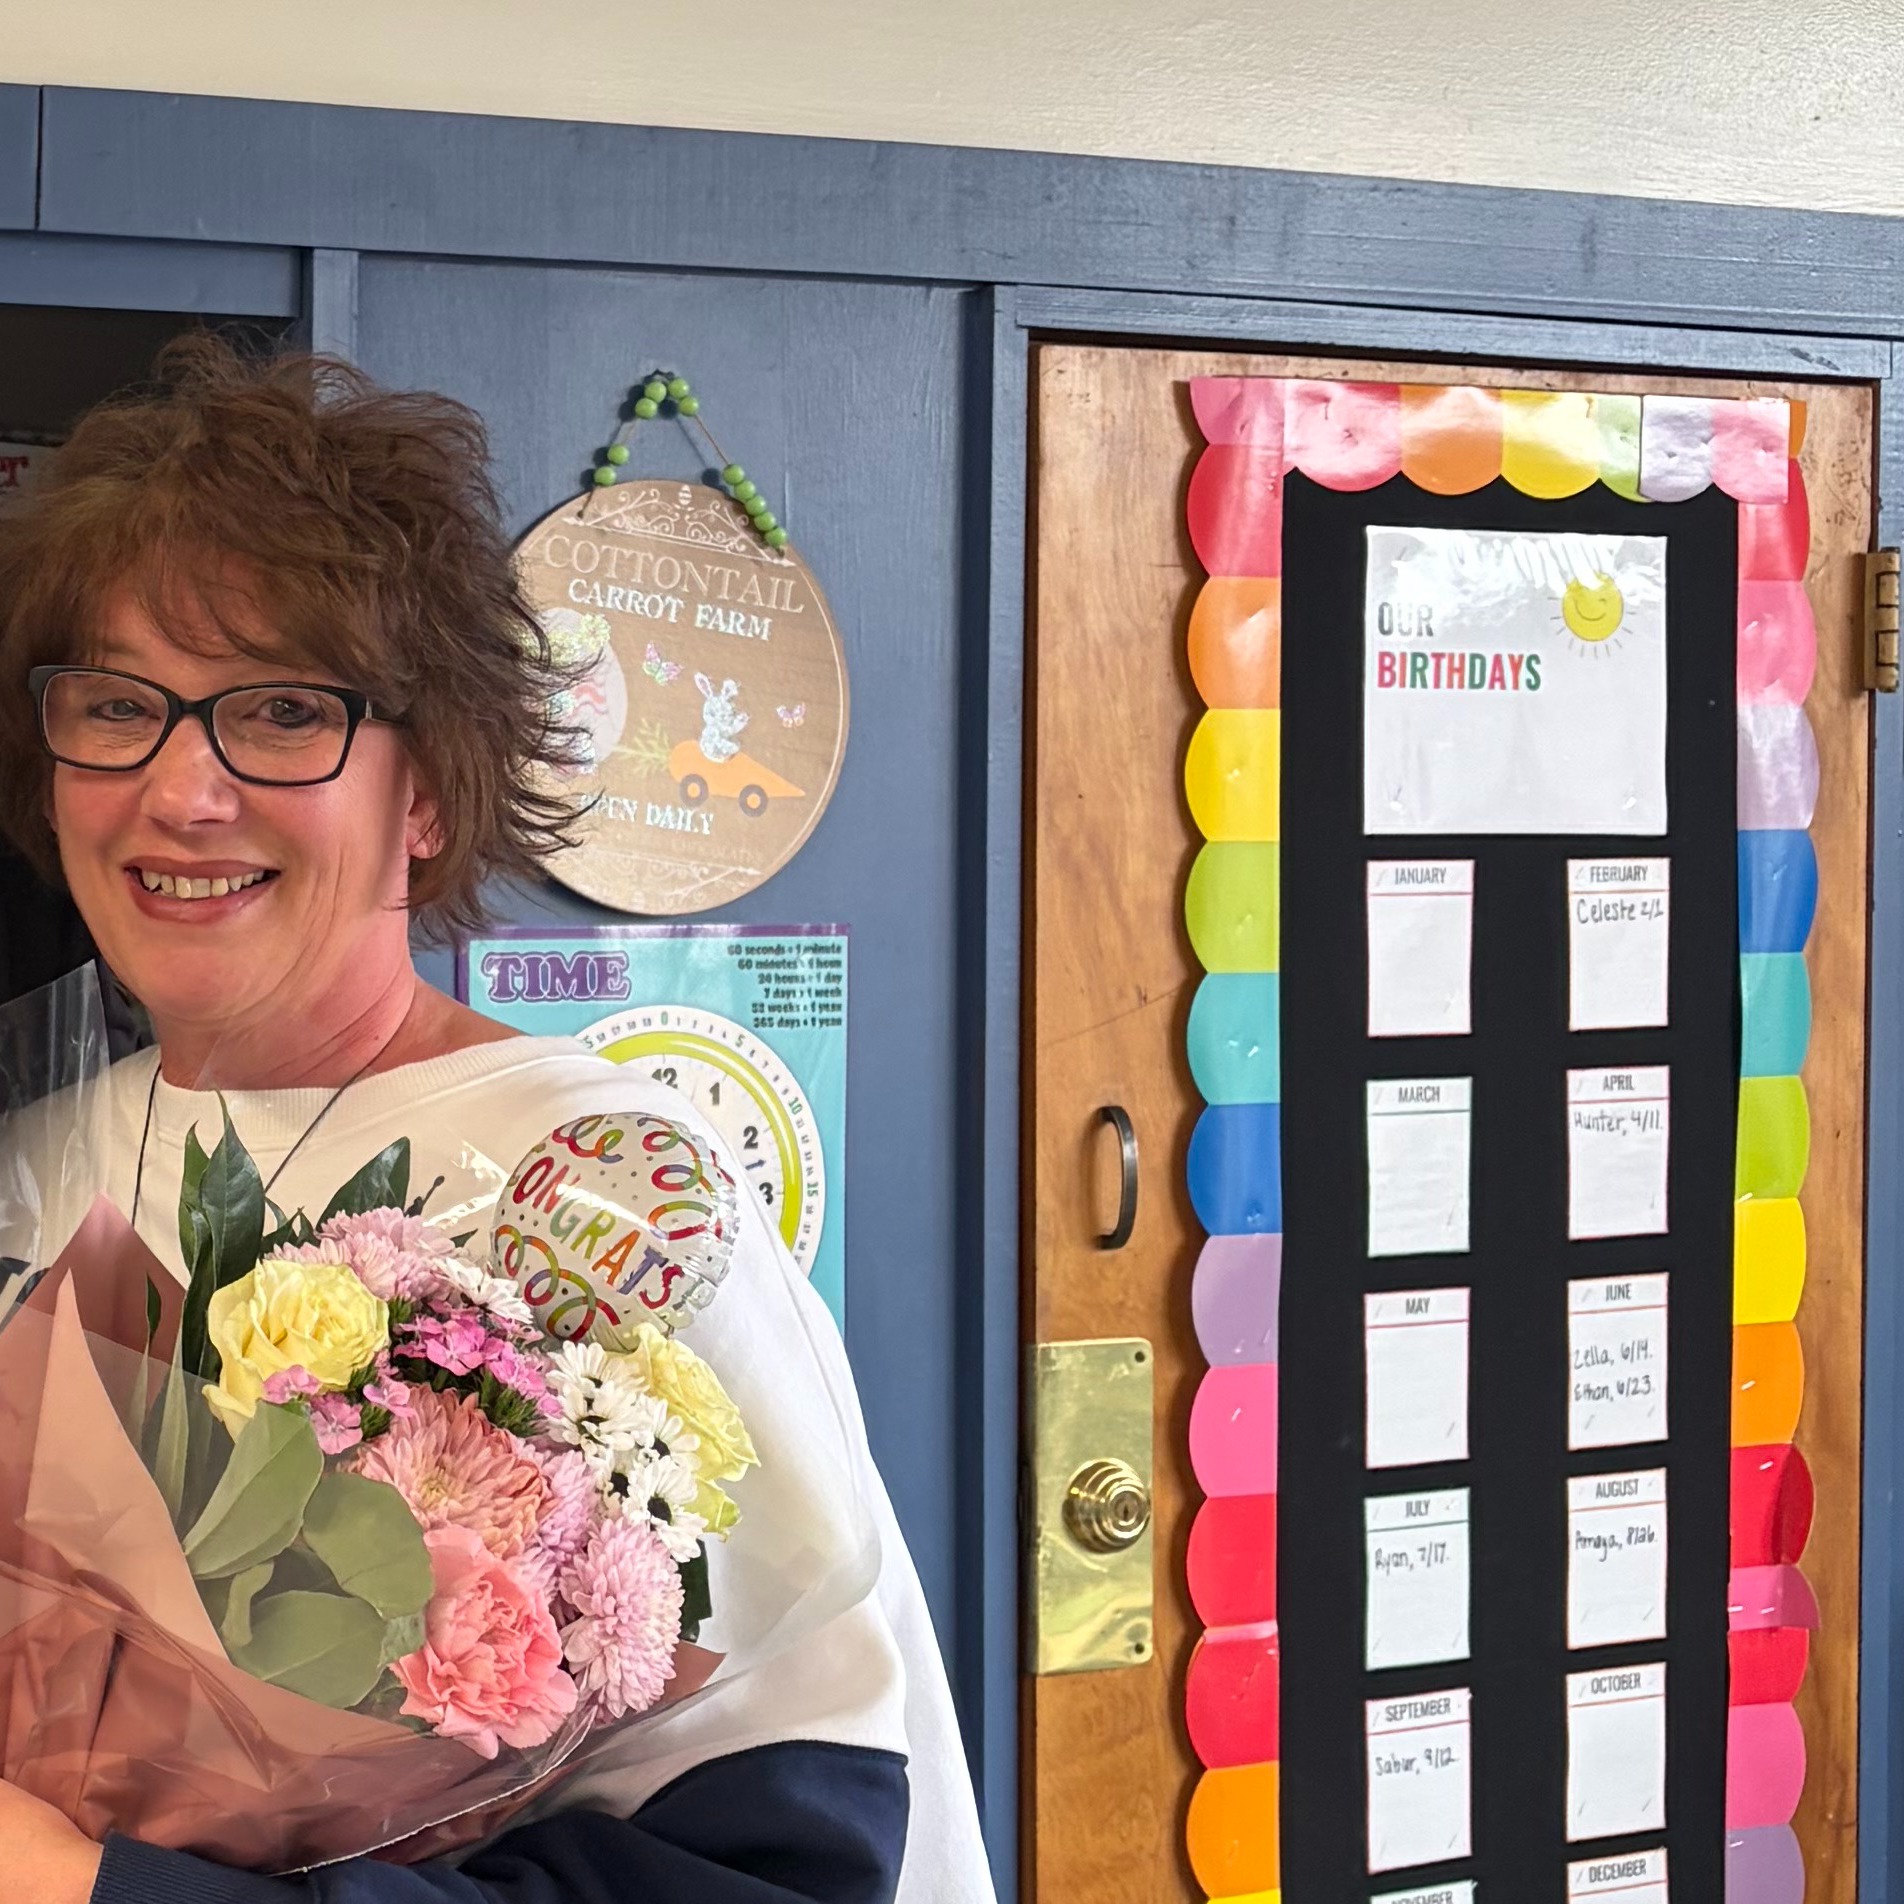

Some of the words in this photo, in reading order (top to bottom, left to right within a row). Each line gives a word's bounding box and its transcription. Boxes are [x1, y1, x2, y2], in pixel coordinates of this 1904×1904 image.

[543, 534, 806, 615] COTTONTAIL
[567, 579, 685, 625] CARROT
[694, 604, 773, 642] FARM
[1378, 601, 1435, 638] OUR
[1377, 651, 1542, 691] BIRTHDAYS
[645, 801, 714, 835] DAILY
[1394, 867, 1447, 885] JANUARY
[1590, 865, 1648, 883] FEBRUARY
[1577, 898, 1636, 924] Celeste
[480, 950, 631, 1003] TIME
[709, 1082, 720, 1106] 1
[1398, 1085, 1440, 1103] MARCH
[1603, 1074, 1635, 1091] APRIL
[1574, 1109, 1627, 1137] Hunter,
[743, 1126, 758, 1149] 2
[759, 1182, 774, 1205] 3
[1606, 1283, 1631, 1301] JUNE
[1406, 1298, 1430, 1314] MAY
[1595, 1478, 1639, 1499] AUGUST
[1405, 1499, 1430, 1518] JULY
[1591, 1672, 1641, 1695] OCTOBER
[1385, 1697, 1451, 1723] SEPTEMBER
[1588, 1858, 1647, 1883] DECEMBER
